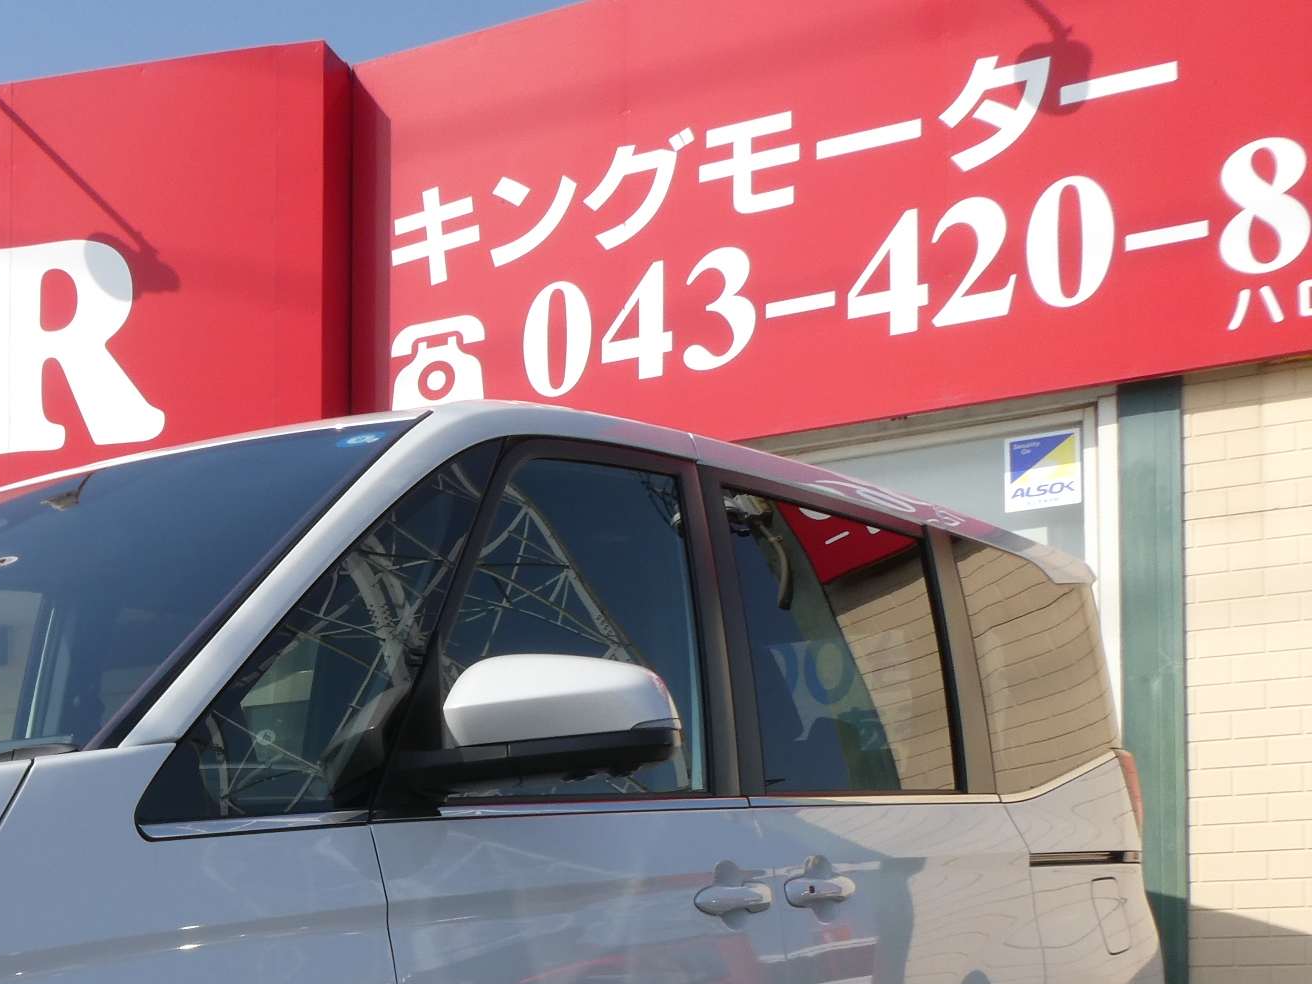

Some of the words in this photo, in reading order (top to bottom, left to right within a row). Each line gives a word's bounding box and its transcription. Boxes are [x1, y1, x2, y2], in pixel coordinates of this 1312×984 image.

[391, 56, 1179, 285] キングモーター
[1011, 480, 1075, 499] ALSOK
